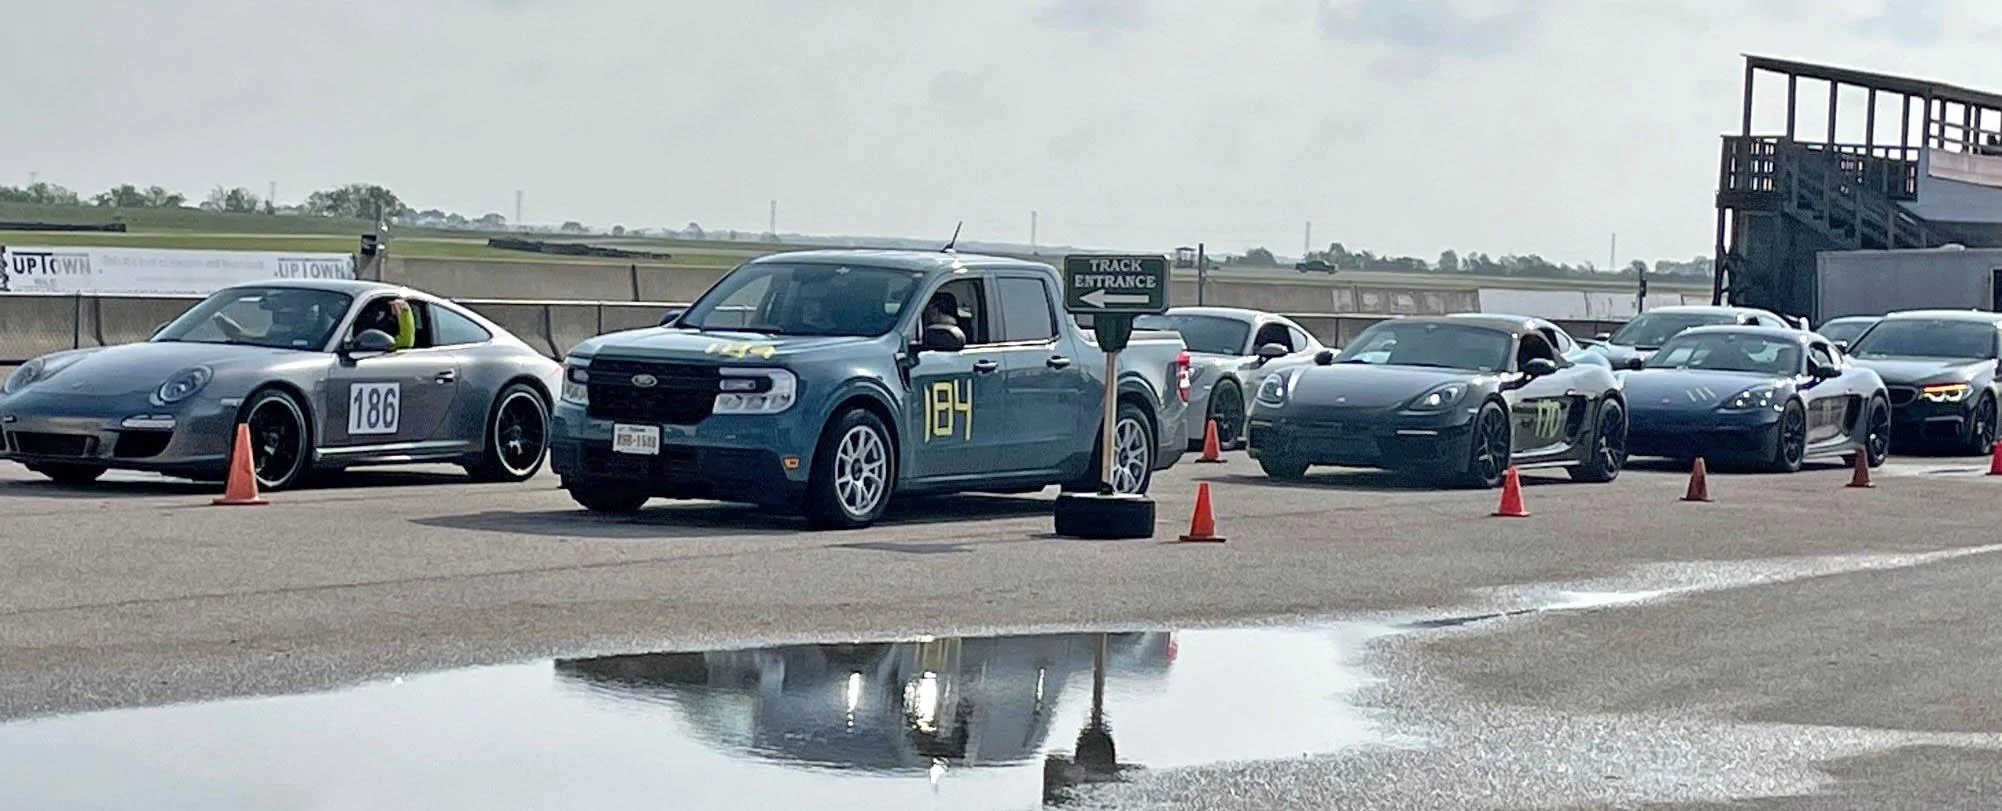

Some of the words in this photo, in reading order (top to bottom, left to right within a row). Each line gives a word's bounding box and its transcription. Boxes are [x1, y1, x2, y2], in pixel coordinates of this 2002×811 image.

[12, 252, 91, 275] UPTOWN
[1089, 259, 1142, 272] TRACK
[1074, 274, 1157, 288] ENTRANCE
[353, 387, 396, 429] 186
[924, 378, 972, 443] 184
